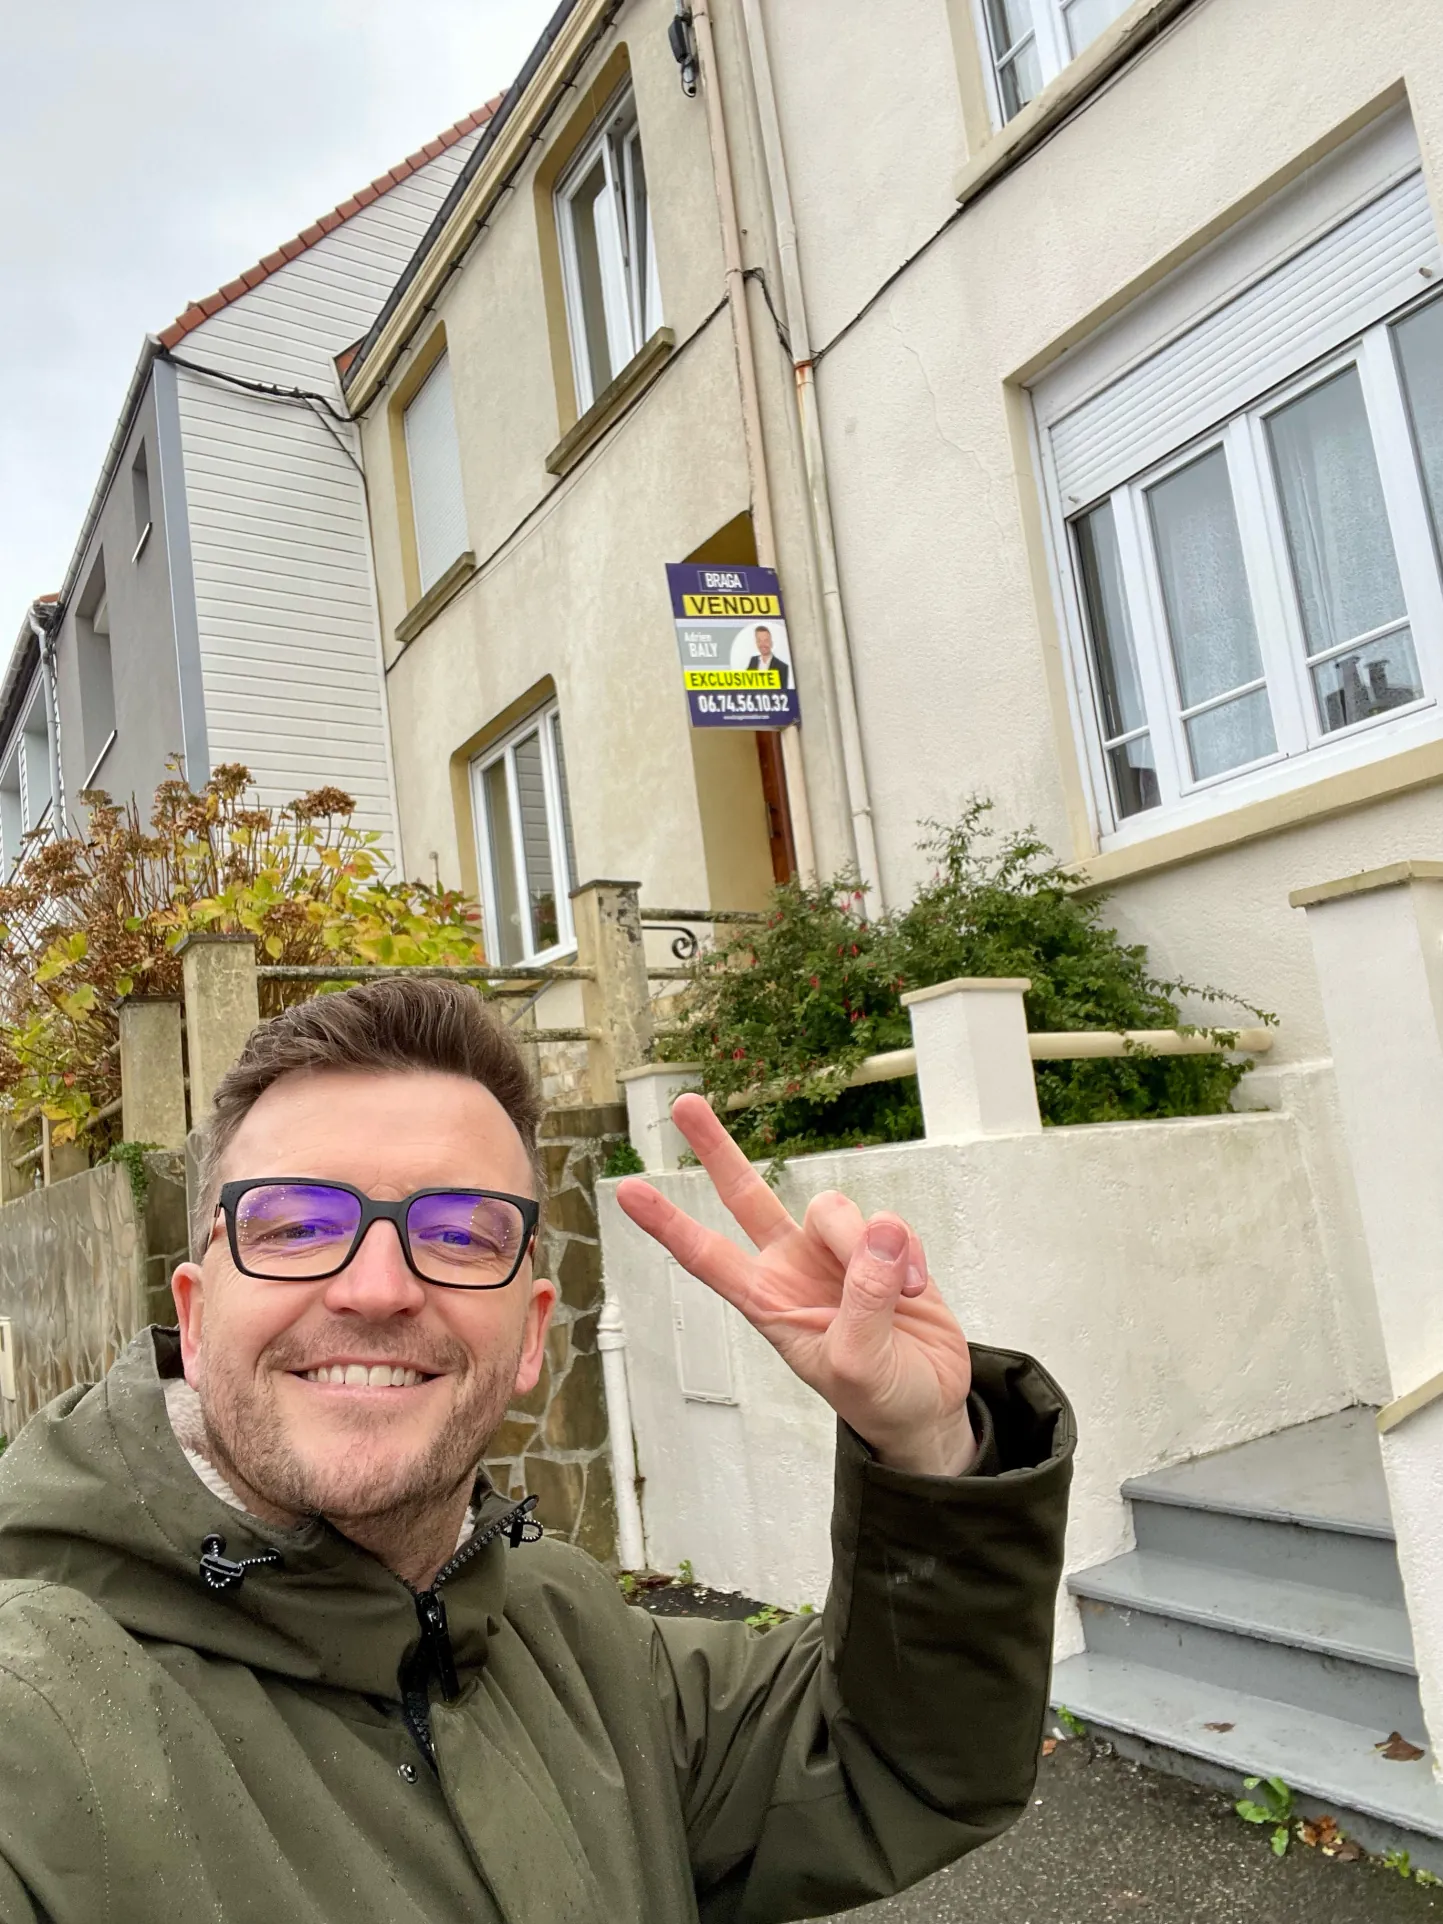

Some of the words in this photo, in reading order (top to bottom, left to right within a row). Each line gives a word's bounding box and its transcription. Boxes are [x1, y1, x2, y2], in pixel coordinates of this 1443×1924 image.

[704, 573, 743, 588] BRAGA
[690, 597, 771, 614] VENDU
[688, 643, 718, 658] BALY
[697, 693, 790, 712] 06.74.56.10.32
